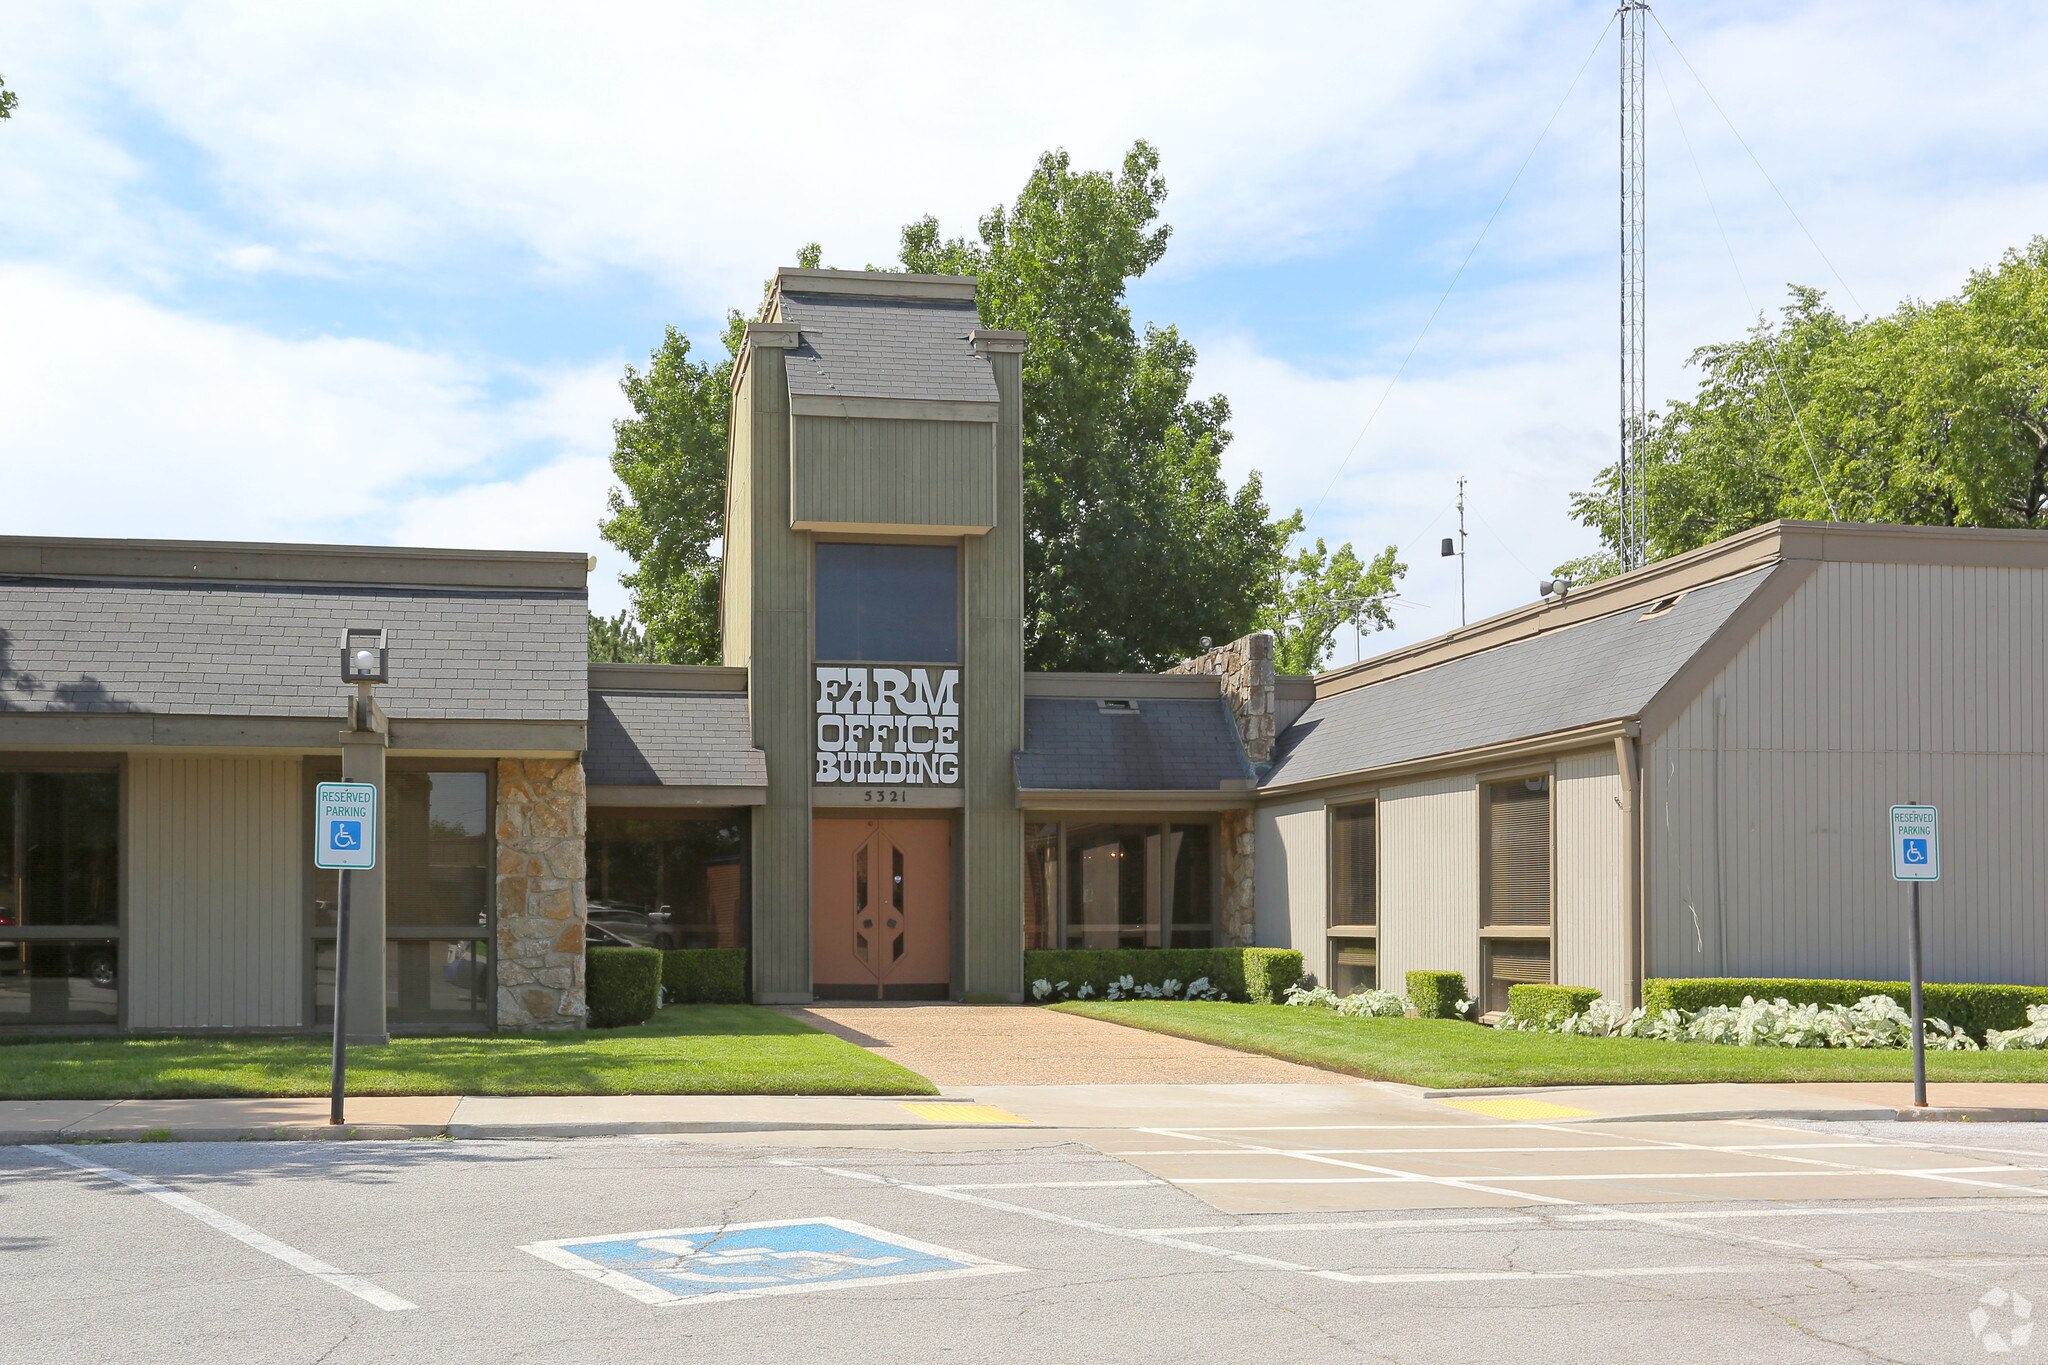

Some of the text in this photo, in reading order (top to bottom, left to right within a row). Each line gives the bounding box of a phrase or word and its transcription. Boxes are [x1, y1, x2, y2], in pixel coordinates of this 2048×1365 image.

[816, 667, 960, 716] FARM
[817, 714, 959, 754] OFFICE
[815, 751, 959, 784] BUILDING
[321, 791, 371, 803] RESERVED
[864, 790, 907, 803] 5321
[325, 805, 367, 818] PARKING
[1894, 813, 1934, 823] RESERVED
[1898, 825, 1931, 835] PARKING
